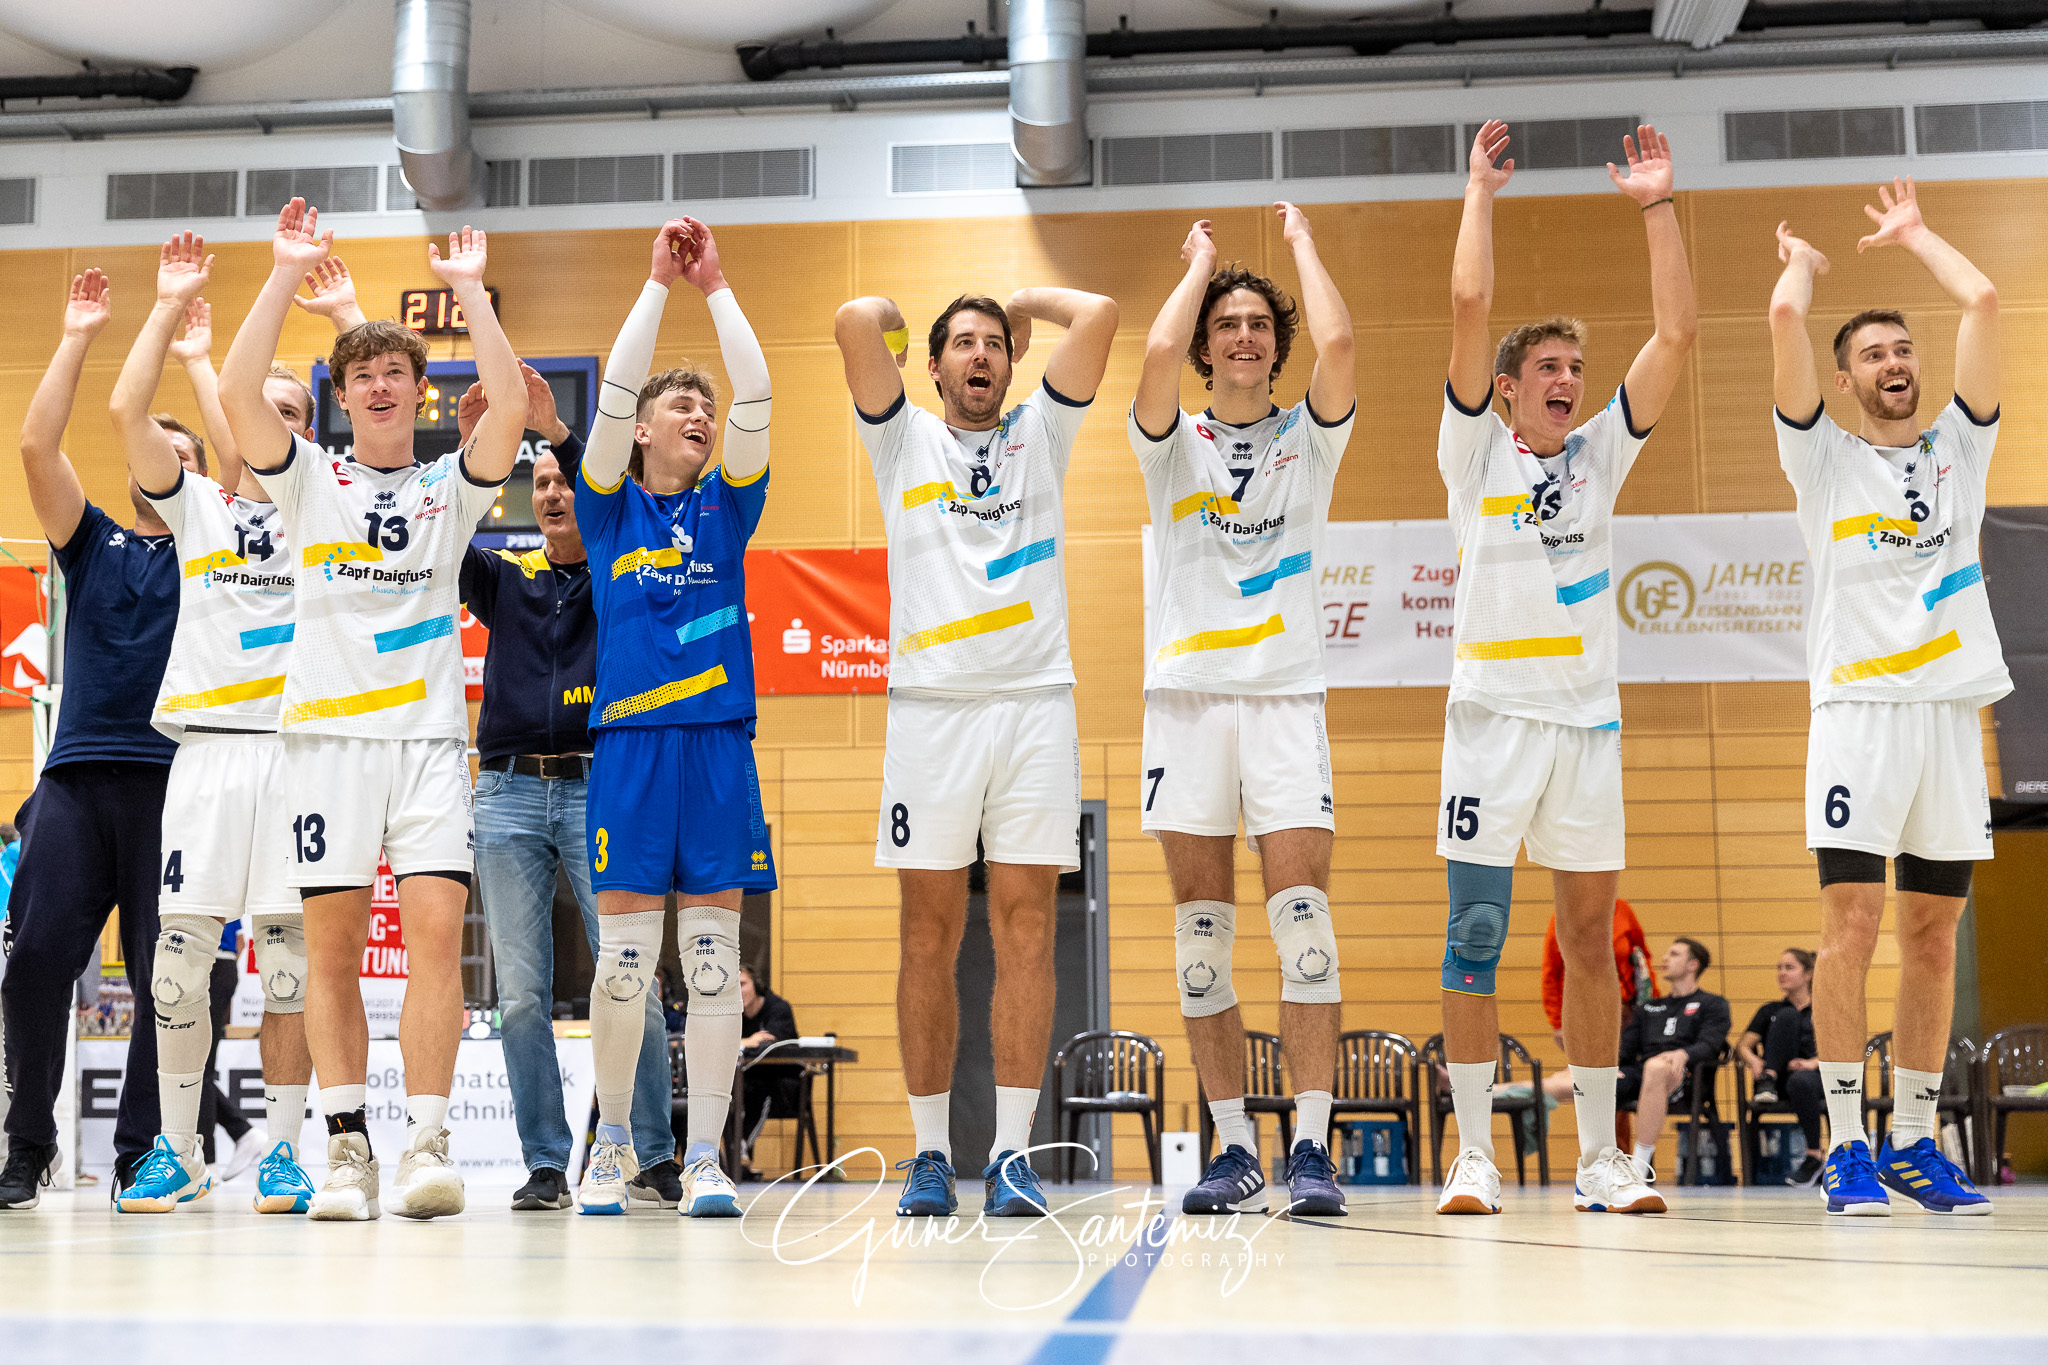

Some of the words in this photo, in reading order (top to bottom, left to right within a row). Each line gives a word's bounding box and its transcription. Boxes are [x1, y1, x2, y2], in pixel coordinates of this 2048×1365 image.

[405, 290, 492, 329] 212
[1228, 467, 1255, 503] 7
[1531, 480, 1563, 521] 15
[1904, 489, 1931, 523] 6
[234, 523, 275, 563] 14
[363, 511, 410, 552] 13
[1539, 532, 1585, 550] aiguss
[337, 563, 371, 581] Zapf
[372, 568, 433, 586] Daigfuss
[642, 564, 673, 585] Zapf
[1702, 560, 1806, 595] JAHRE
[820, 634, 889, 657] Sparka
[1145, 767, 1165, 813] 7
[1824, 785, 1852, 829] 6
[292, 812, 327, 864] 13
[890, 802, 911, 848] 8
[1446, 795, 1481, 842] 15
[594, 827, 609, 873] 3
[158, 850, 184, 896] 4
[368, 913, 399, 942] G-
